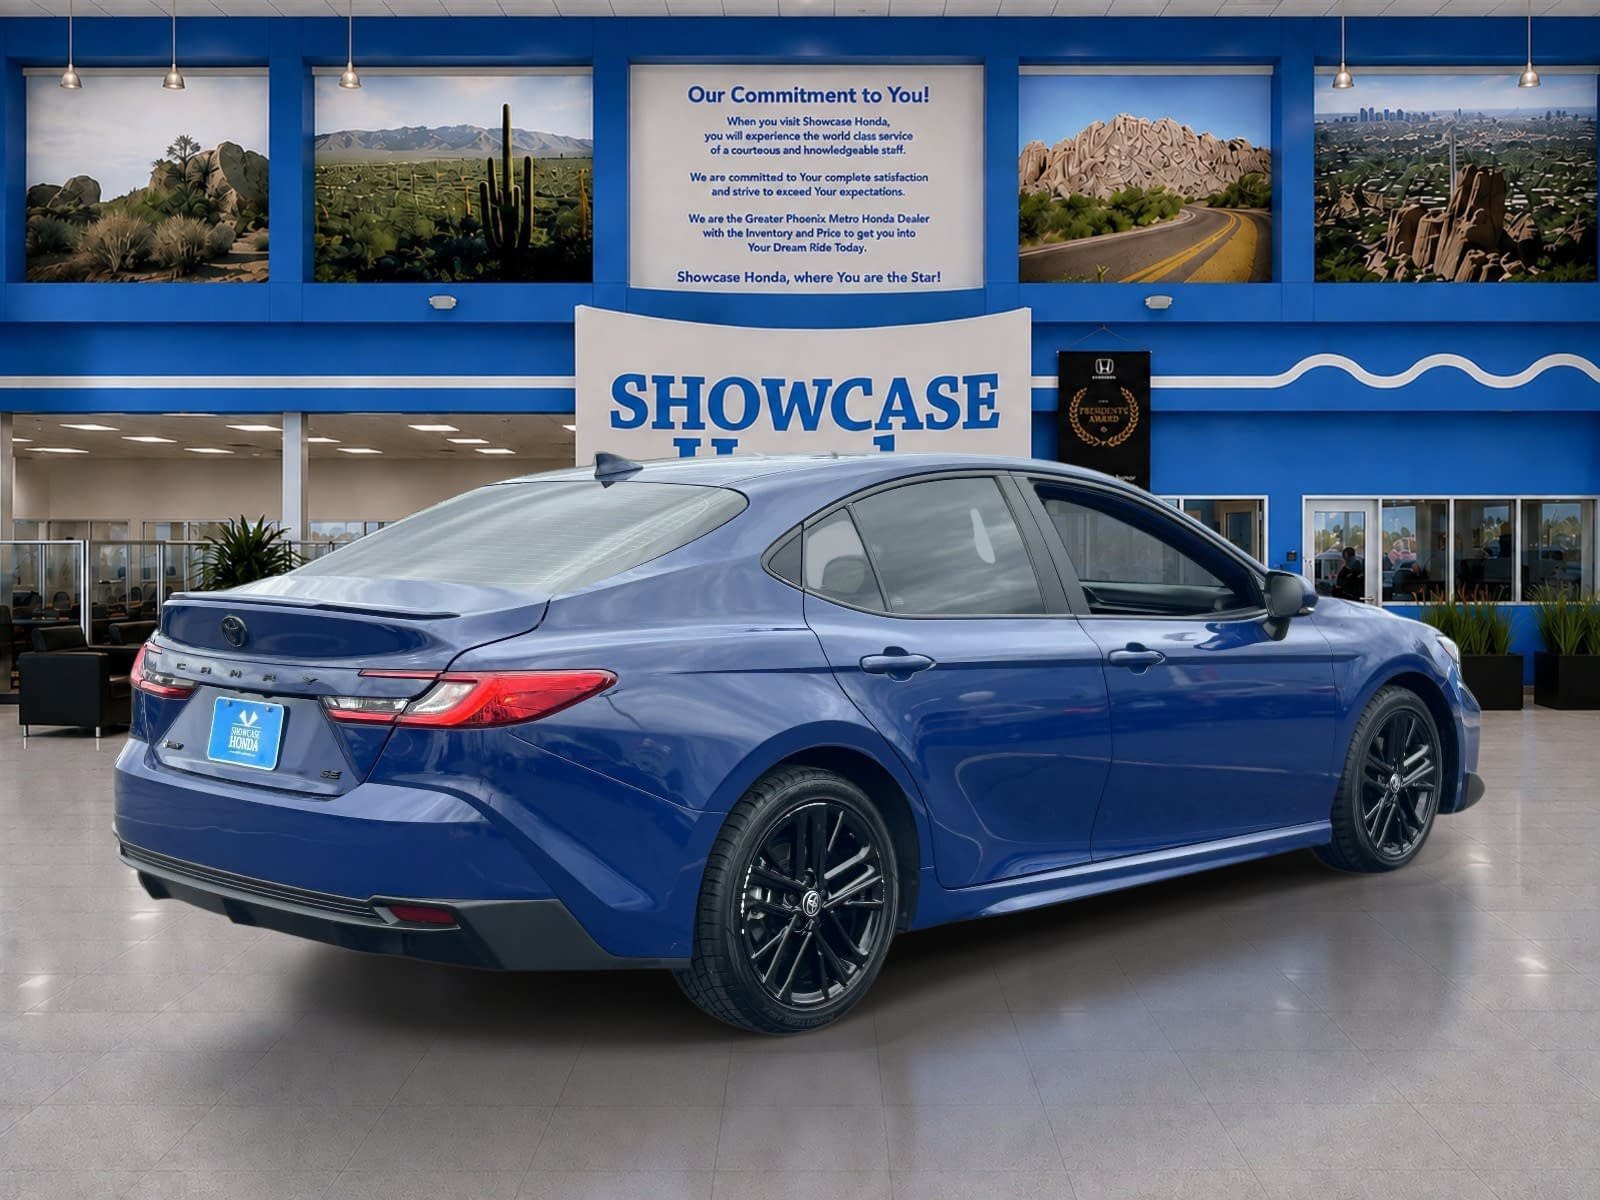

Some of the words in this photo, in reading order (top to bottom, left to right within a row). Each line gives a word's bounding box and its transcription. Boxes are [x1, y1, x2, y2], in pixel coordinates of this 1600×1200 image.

[687, 86, 726, 103] Our
[730, 86, 857, 103] Commitment
[861, 88, 883, 103] to
[886, 86, 930, 103] You!
[726, 116, 757, 126] When
[758, 119, 778, 128] you
[779, 117, 801, 126] visit
[802, 116, 853, 126] Showcase
[854, 117, 891, 127] Honda,
[704, 133, 724, 143] you
[725, 131, 743, 140] will
[744, 131, 801, 143] experience
[802, 131, 821, 140] the
[821, 131, 851, 141] world
[852, 131, 877, 141] class
[878, 131, 914, 141] service
[710, 145, 722, 154] of
[730, 147, 781, 155] courteous
[782, 145, 802, 154] and
[881, 145, 906, 154] staff.
[689, 172, 708, 182] We
[728, 172, 784, 182] committed
[785, 174, 798, 182] to
[799, 173, 823, 182] Your
[824, 172, 872, 184] complete
[873, 172, 929, 182] satisfaction
[711, 186, 731, 196] and
[732, 187, 761, 196] strive
[762, 188, 774, 196] to
[775, 187, 812, 196] exceed
[814, 187, 838, 196] Your
[838, 186, 906, 199] expectations.
[688, 214, 706, 224] We
[725, 213, 743, 223] the
[744, 214, 785, 223] Greater
[785, 214, 827, 223] Phoenix
[828, 214, 860, 223] Metro
[861, 214, 895, 223] Honda
[897, 214, 931, 223] Dealer
[702, 228, 725, 237] with
[726, 228, 744, 238] the
[745, 228, 794, 240] Inventory
[794, 228, 815, 238] and
[816, 228, 842, 238] Price
[843, 230, 855, 238] to
[856, 230, 875, 240] get
[876, 230, 895, 240] you
[896, 228, 917, 238] into
[747, 243, 772, 252] Your
[773, 243, 808, 252] Dream
[809, 243, 833, 252] Ride
[833, 243, 868, 254] Today.
[676, 271, 741, 283] Showcase
[744, 271, 790, 285] Honda,
[793, 271, 834, 283] where
[836, 272, 861, 283] You
[863, 275, 884, 283] are
[886, 271, 908, 283] the
[910, 271, 942, 283] Star!
[609, 372, 1001, 432] SHOWCASE
[176, 663, 318, 685] CAMRY
[231, 727, 262, 739] SHOWCASE
[228, 736, 259, 752] HONDA
